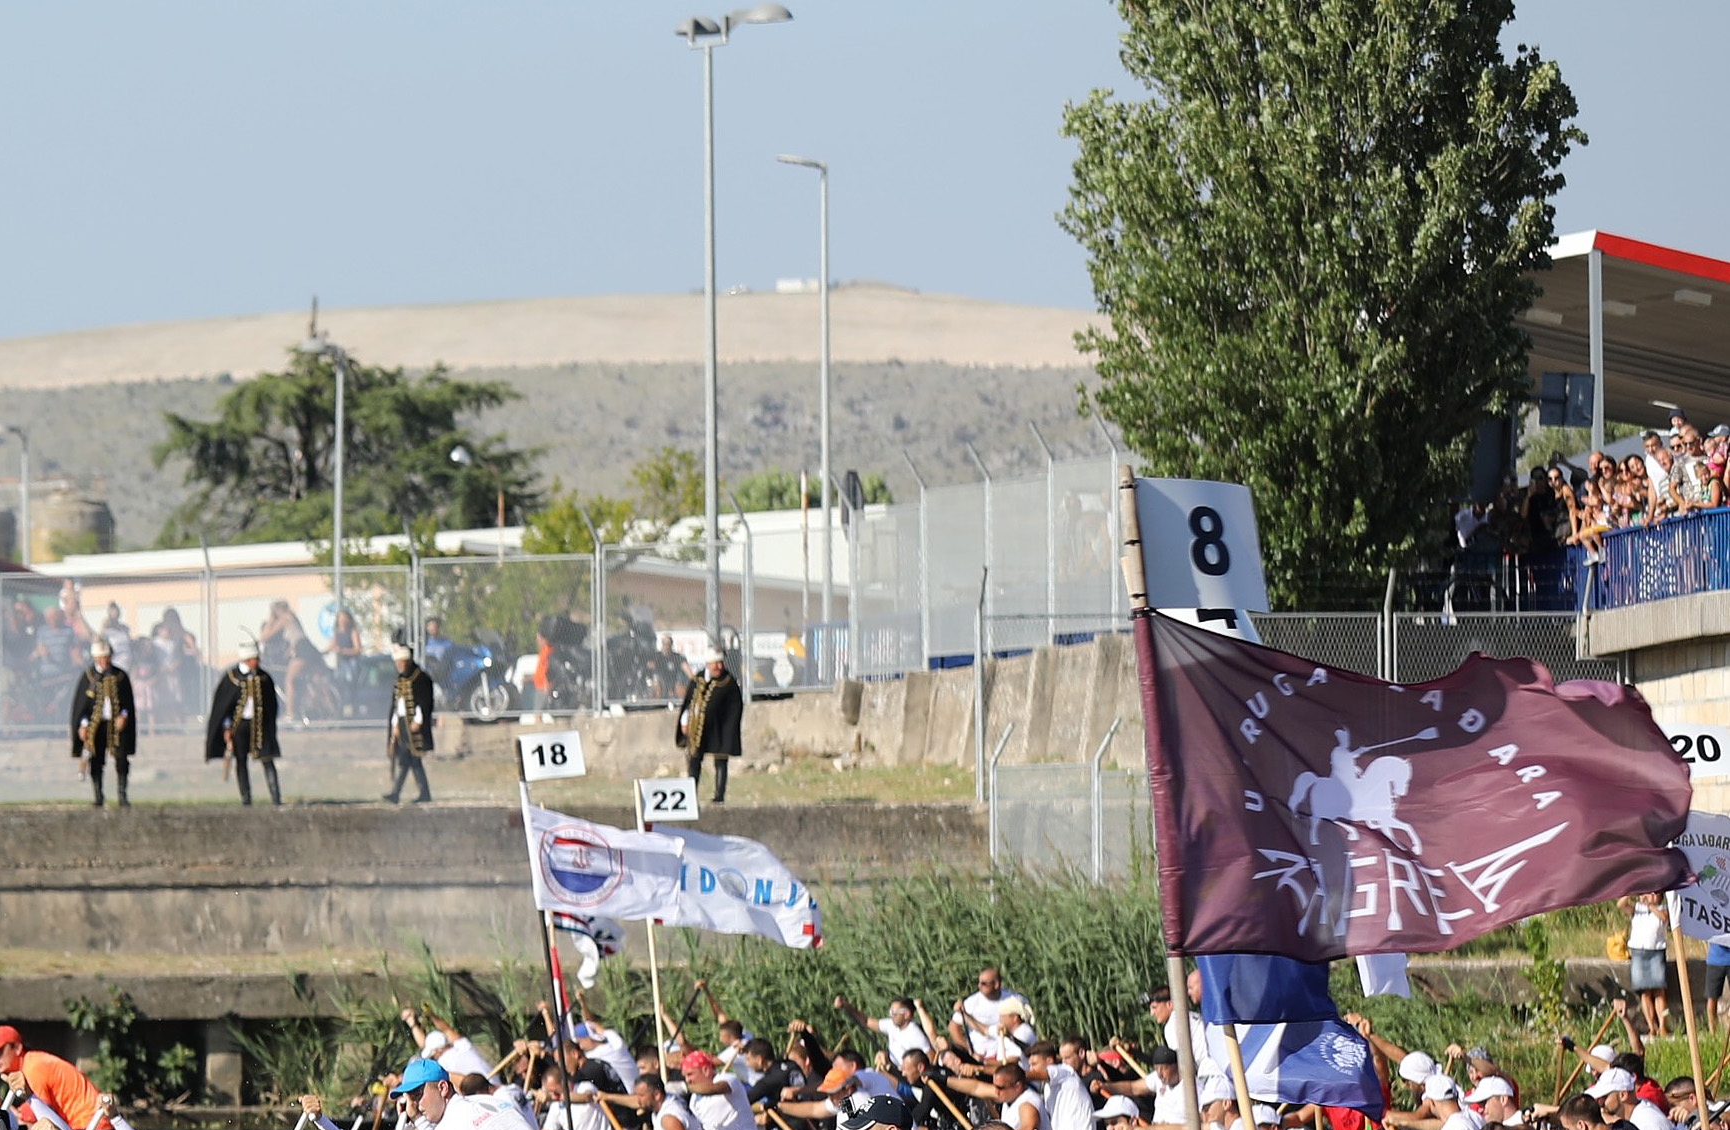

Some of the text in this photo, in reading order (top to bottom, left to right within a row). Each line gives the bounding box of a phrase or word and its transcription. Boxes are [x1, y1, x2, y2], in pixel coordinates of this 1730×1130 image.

[1188, 506, 1230, 576] 8
[1240, 667, 1563, 812] URUGA AĐARA
[1671, 734, 1721, 763] 20
[531, 743, 568, 767] 18
[652, 790, 687, 811] 22
